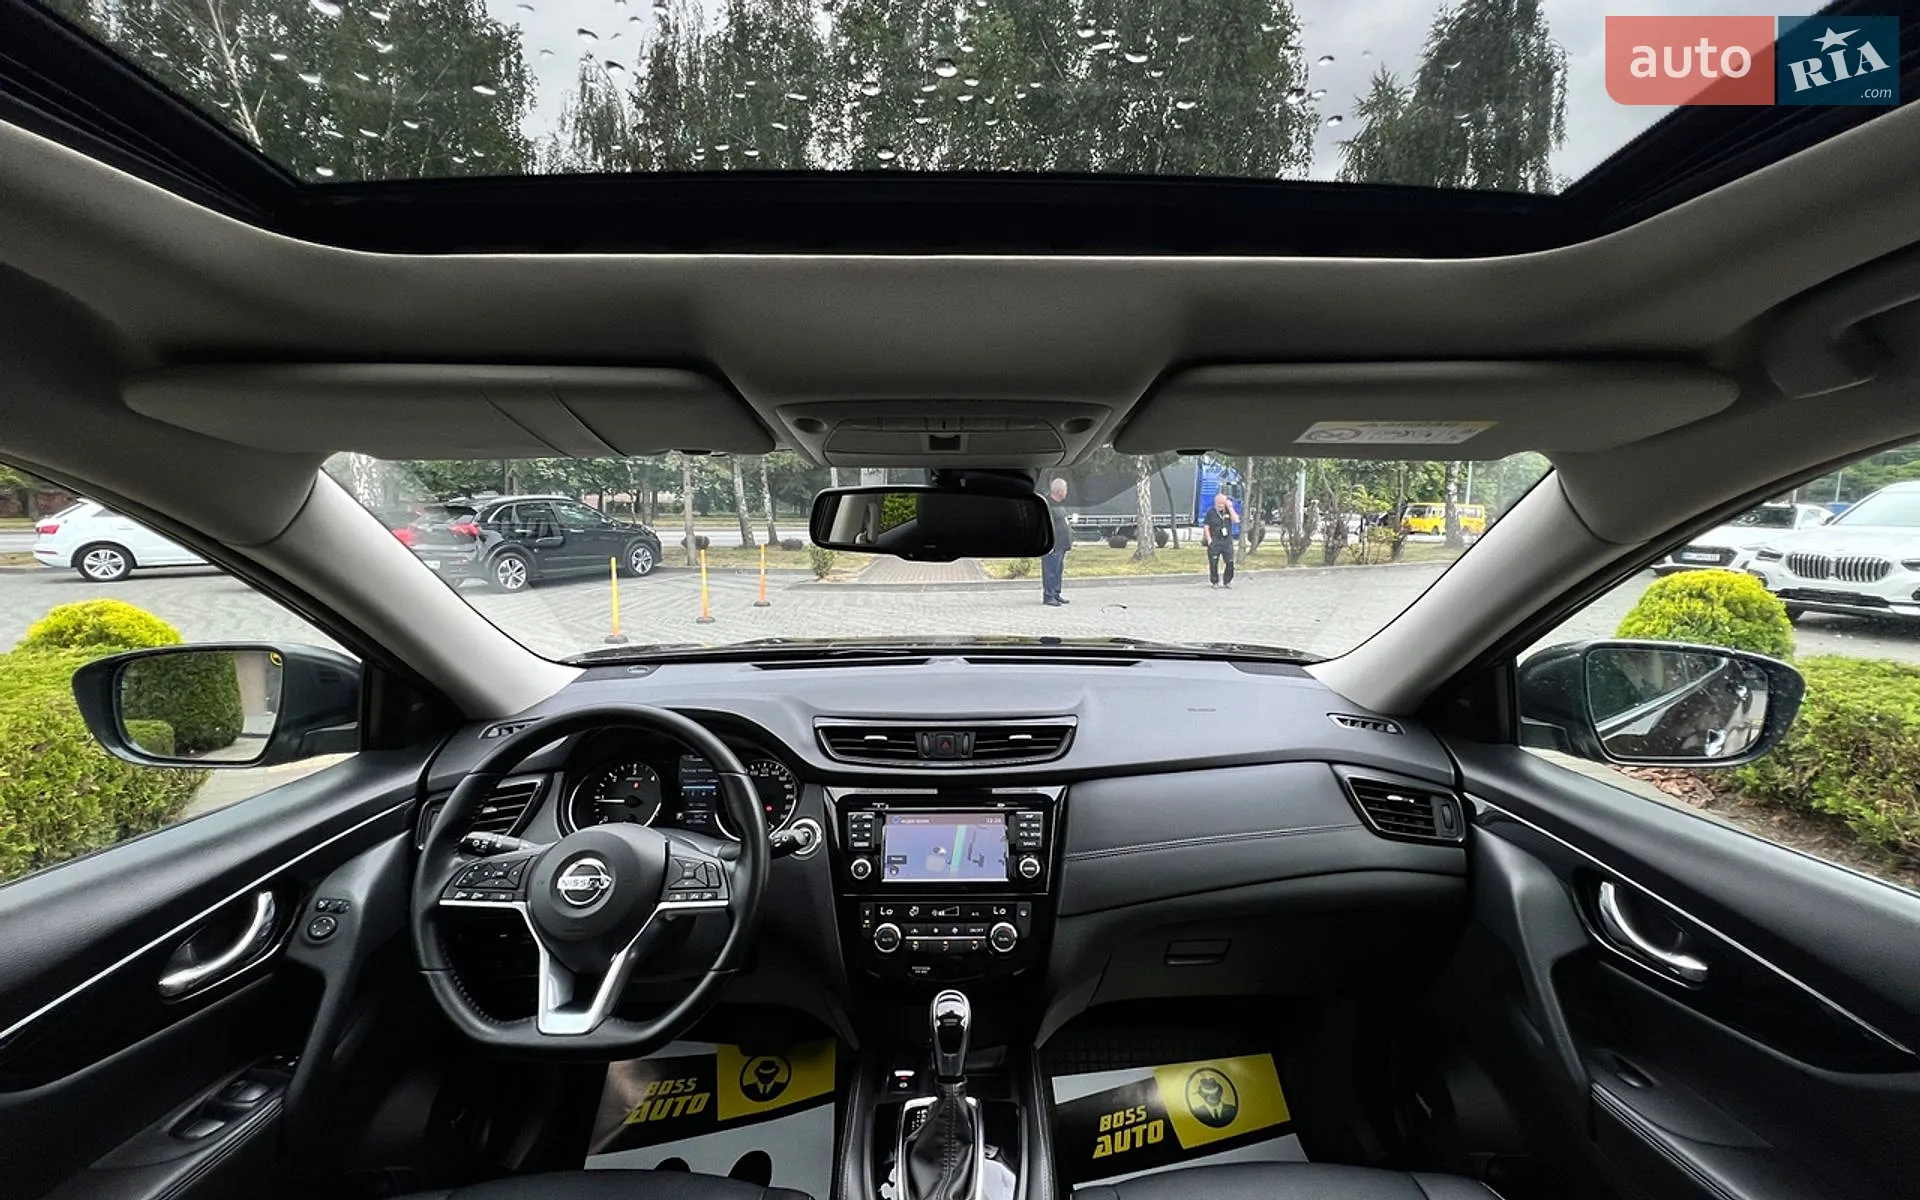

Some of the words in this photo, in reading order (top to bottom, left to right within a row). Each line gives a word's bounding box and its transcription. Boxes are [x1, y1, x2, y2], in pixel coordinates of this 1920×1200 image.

[643, 1077, 697, 1098] BOSS
[623, 1092, 711, 1125] AUTO
[1099, 1105, 1147, 1132] BOSS
[1092, 1119, 1164, 1159] AUTO
